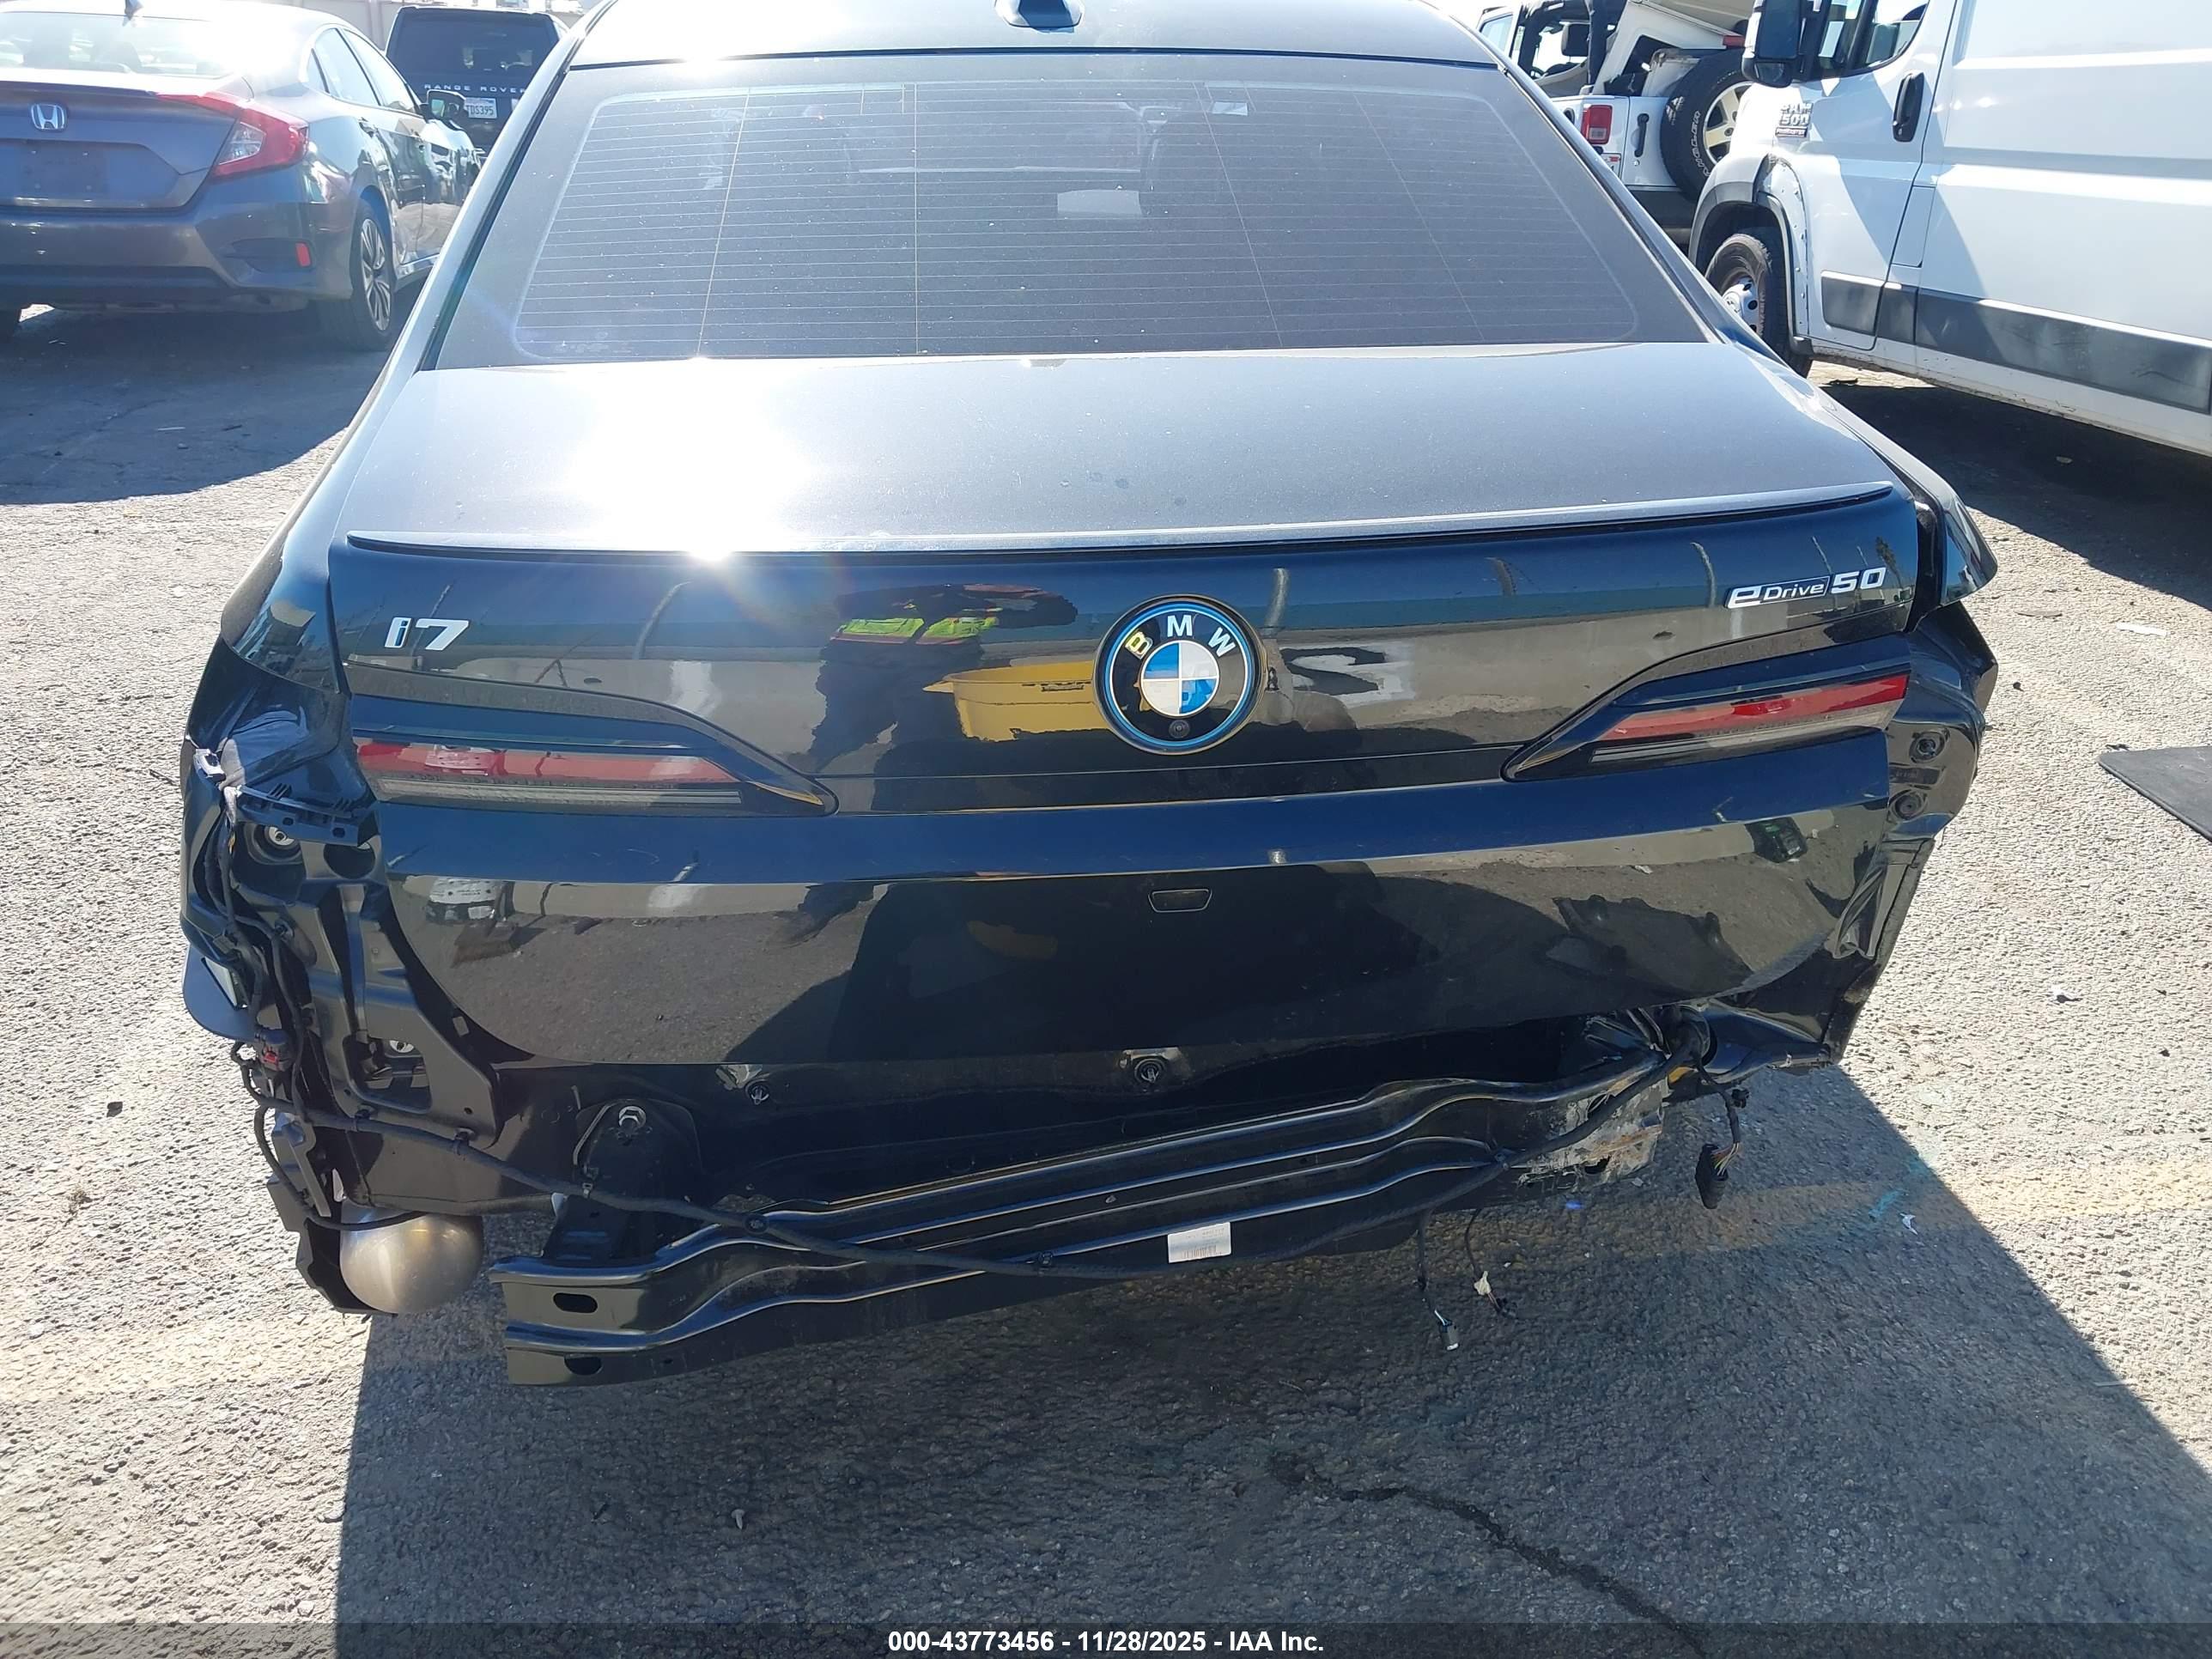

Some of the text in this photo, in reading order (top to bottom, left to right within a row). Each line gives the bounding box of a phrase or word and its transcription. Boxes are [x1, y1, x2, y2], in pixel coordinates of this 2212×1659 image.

[465, 105, 495, 116] TDS395
[1776, 112, 1811, 126] 500
[1691, 111, 1711, 177] ANGLER
[385, 617, 469, 651] i7
[1125, 614, 1237, 659] BMW
